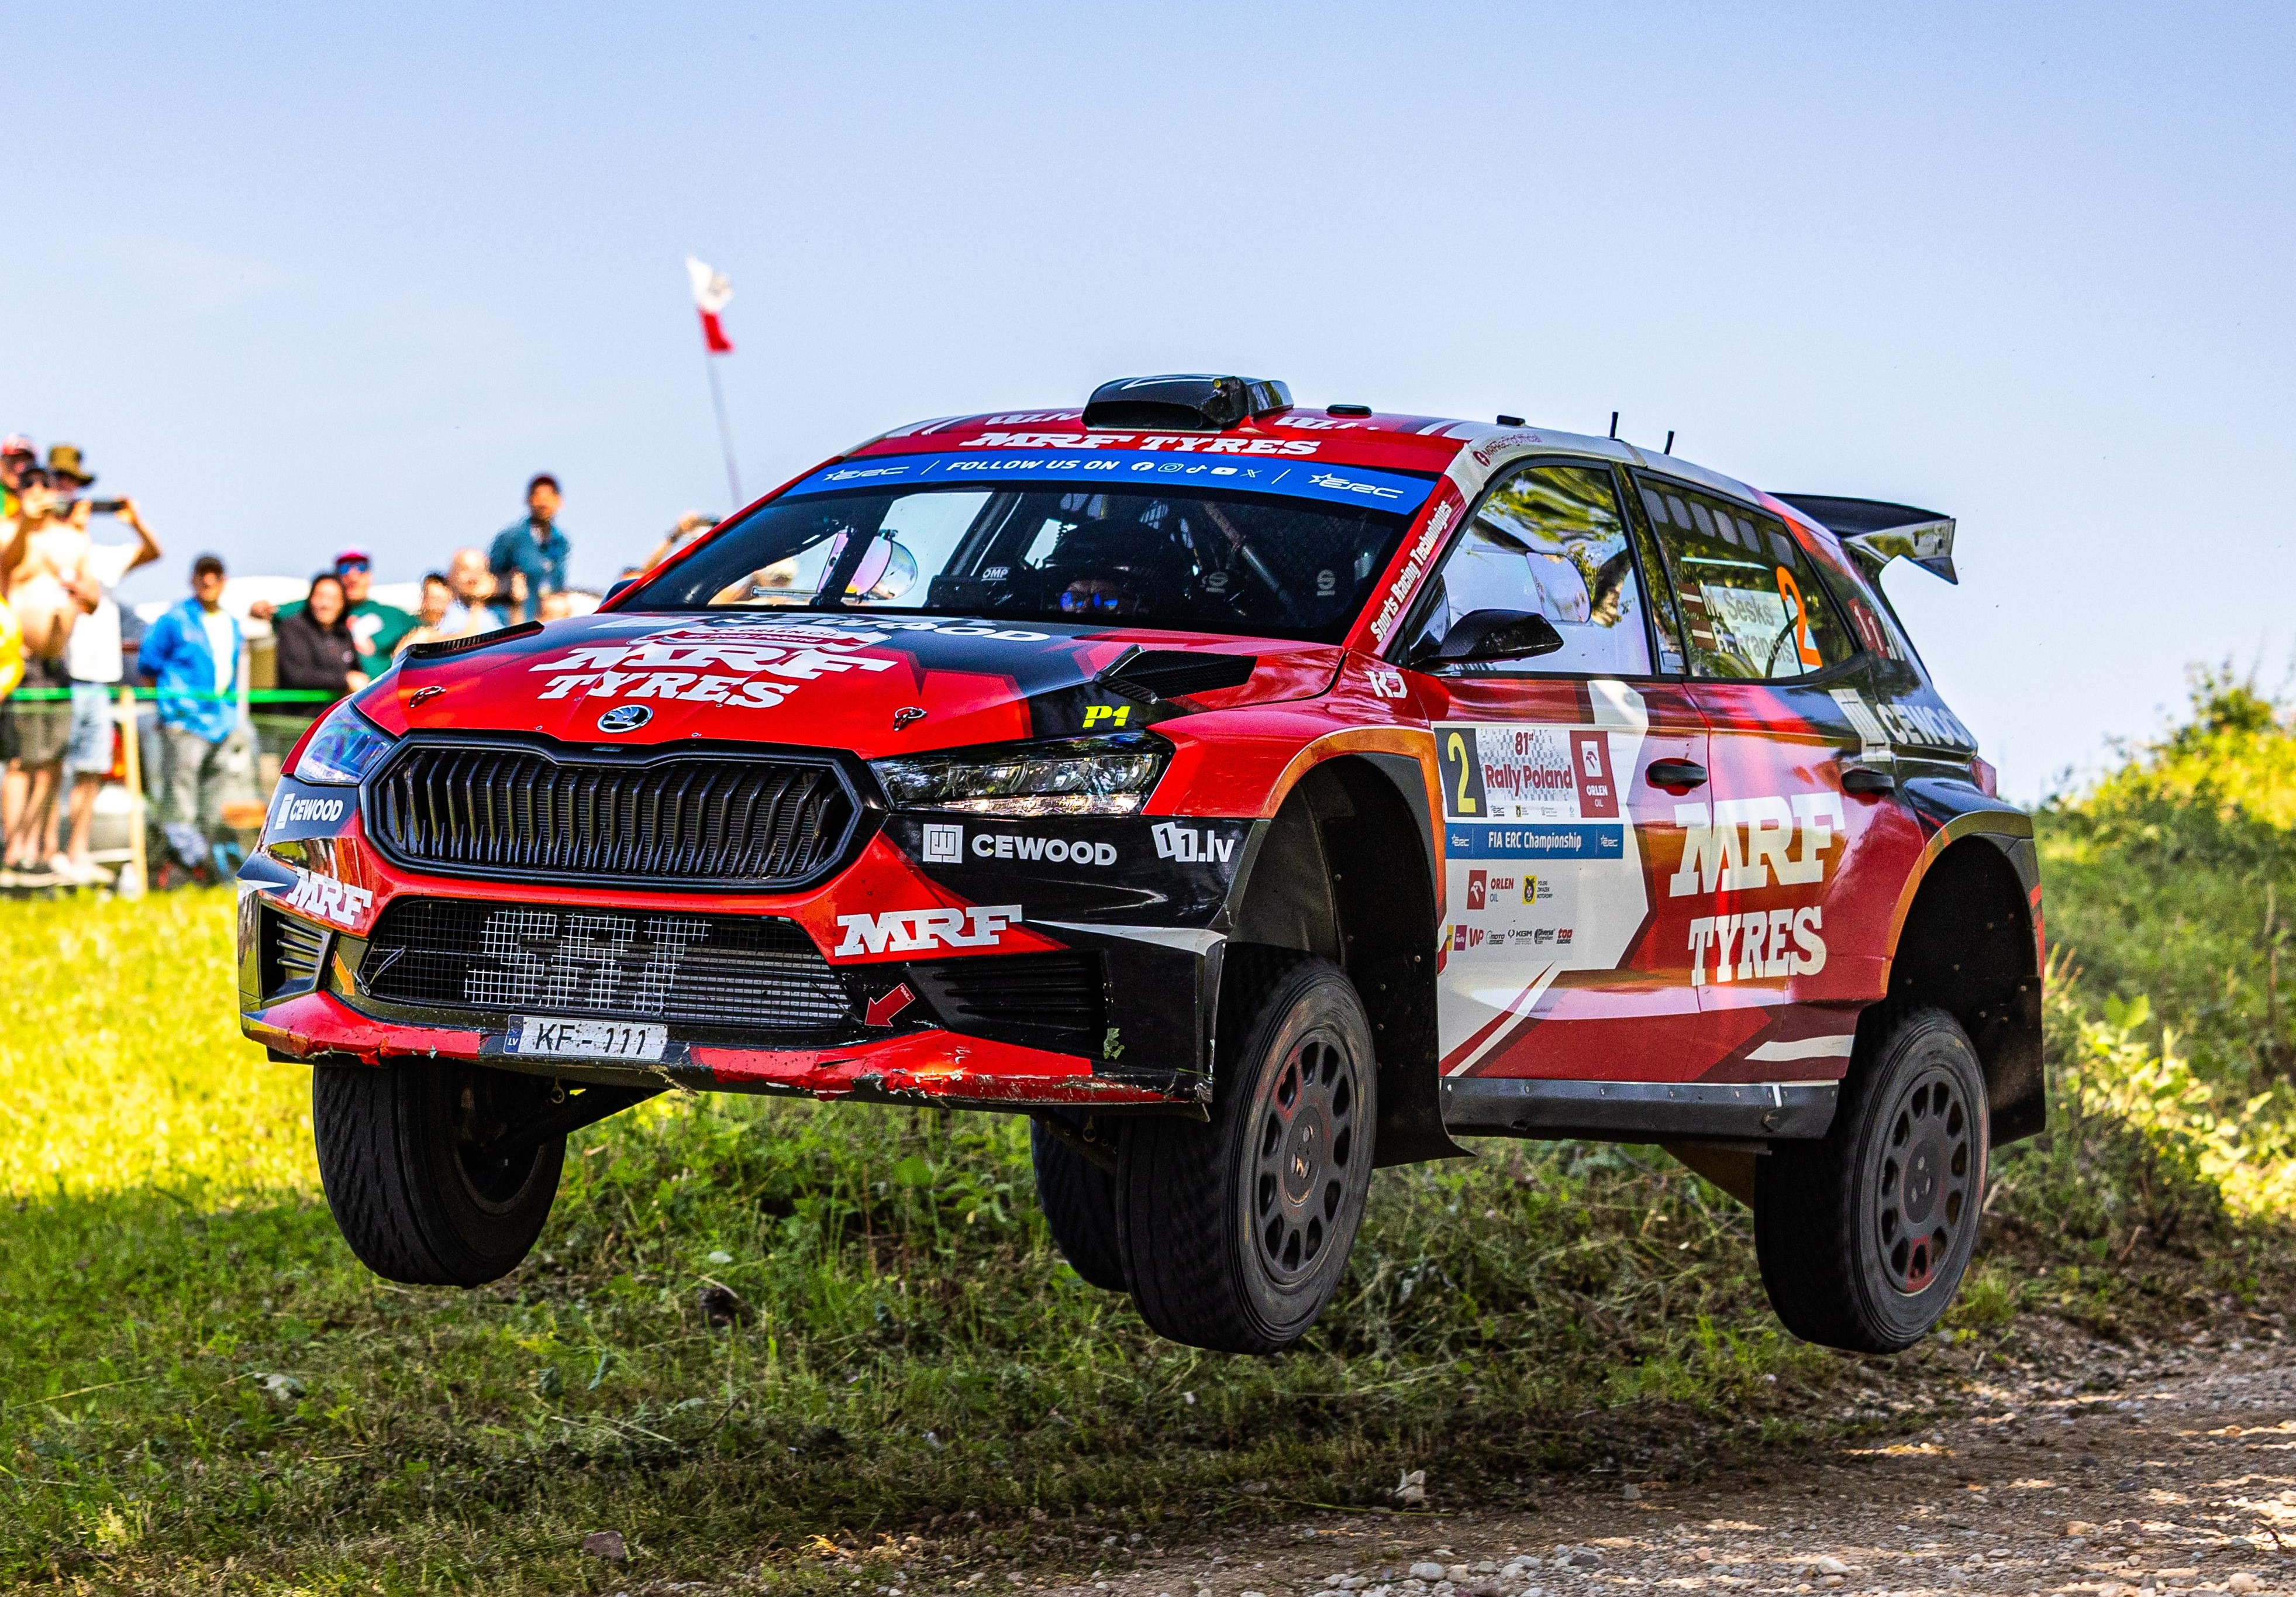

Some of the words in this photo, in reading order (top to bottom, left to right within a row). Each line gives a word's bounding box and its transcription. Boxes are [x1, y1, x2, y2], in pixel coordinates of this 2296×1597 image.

[959, 433, 1135, 449] MRF
[1139, 436, 1322, 455] TYRES
[946, 460, 1049, 471] FOLLOW
[1046, 460, 1081, 470] US
[1083, 460, 1121, 470] ON
[982, 568, 1009, 579] OMP
[1370, 596, 1399, 642] Sports
[1391, 560, 1421, 604] Racing
[1409, 500, 1453, 566] Technologies
[1699, 580, 1722, 617] M.
[1722, 589, 1775, 627] Sesks
[1776, 566, 1823, 667] 2
[1711, 620, 1735, 653] R.
[1731, 625, 1795, 664] Francis
[529, 644, 899, 680] MRF
[537, 672, 801, 709] TYRES
[1081, 705, 1131, 728] P1
[1447, 732, 1477, 813] 2
[1484, 763, 1521, 797] Rally
[1523, 765, 1573, 789] Poland
[1586, 784, 1608, 797] ORLEN
[1594, 798, 1604, 807] OIL
[290, 798, 344, 821] CEWOOD
[971, 834, 1118, 866] CEWOOD
[1151, 821, 1235, 863] 11.lv
[1488, 831, 1503, 848] FIA
[1505, 831, 1522, 848] ERC
[1523, 831, 1582, 852] Championship
[1668, 791, 1846, 898] MRF
[285, 866, 374, 926] MRF
[1490, 877, 1515, 890] ORLEN
[1490, 893, 1499, 903] OIL
[835, 904, 1022, 957] MRF
[1687, 906, 1828, 987] TYRES
[506, 1038, 519, 1047] LV
